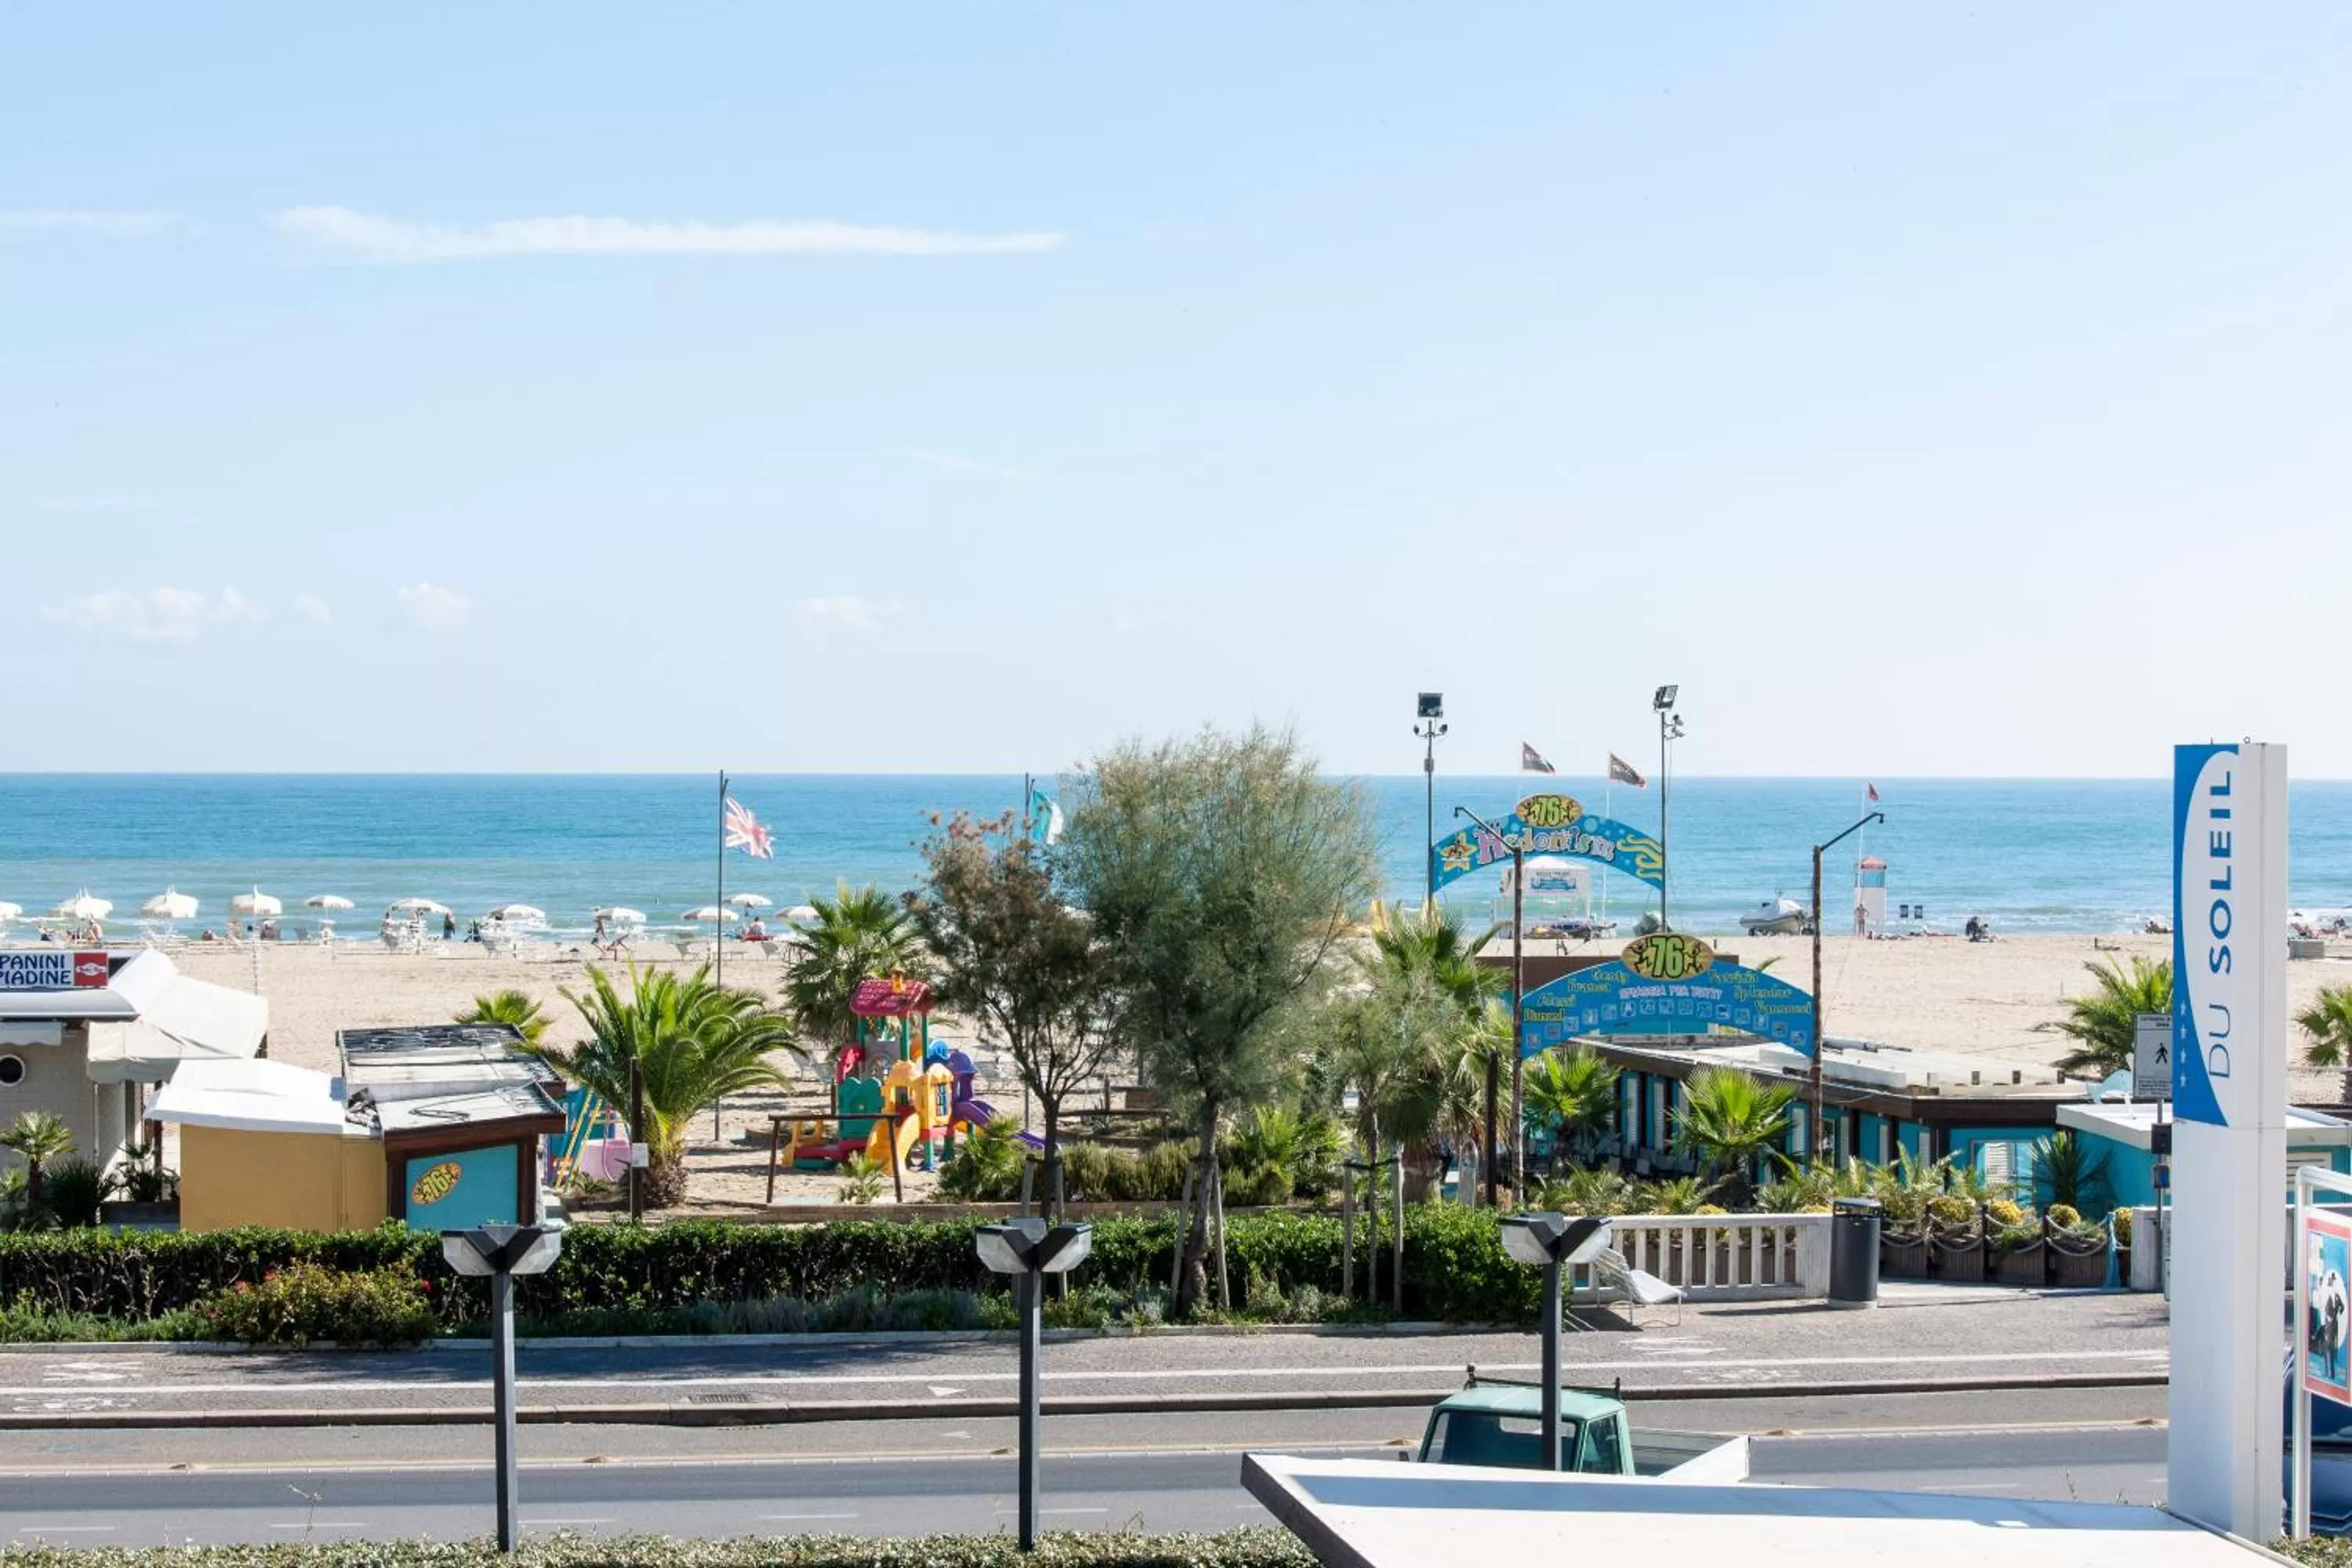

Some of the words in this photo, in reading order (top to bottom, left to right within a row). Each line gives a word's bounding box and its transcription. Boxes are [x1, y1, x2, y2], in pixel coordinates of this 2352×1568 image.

[1536, 795, 1561, 826] 76
[1474, 825, 1616, 866] Hedonism
[2209, 771, 2232, 975] SOLEIL
[0, 953, 65, 969] PANINI
[1650, 935, 1685, 979] 76
[2209, 1004, 2231, 1079] DU
